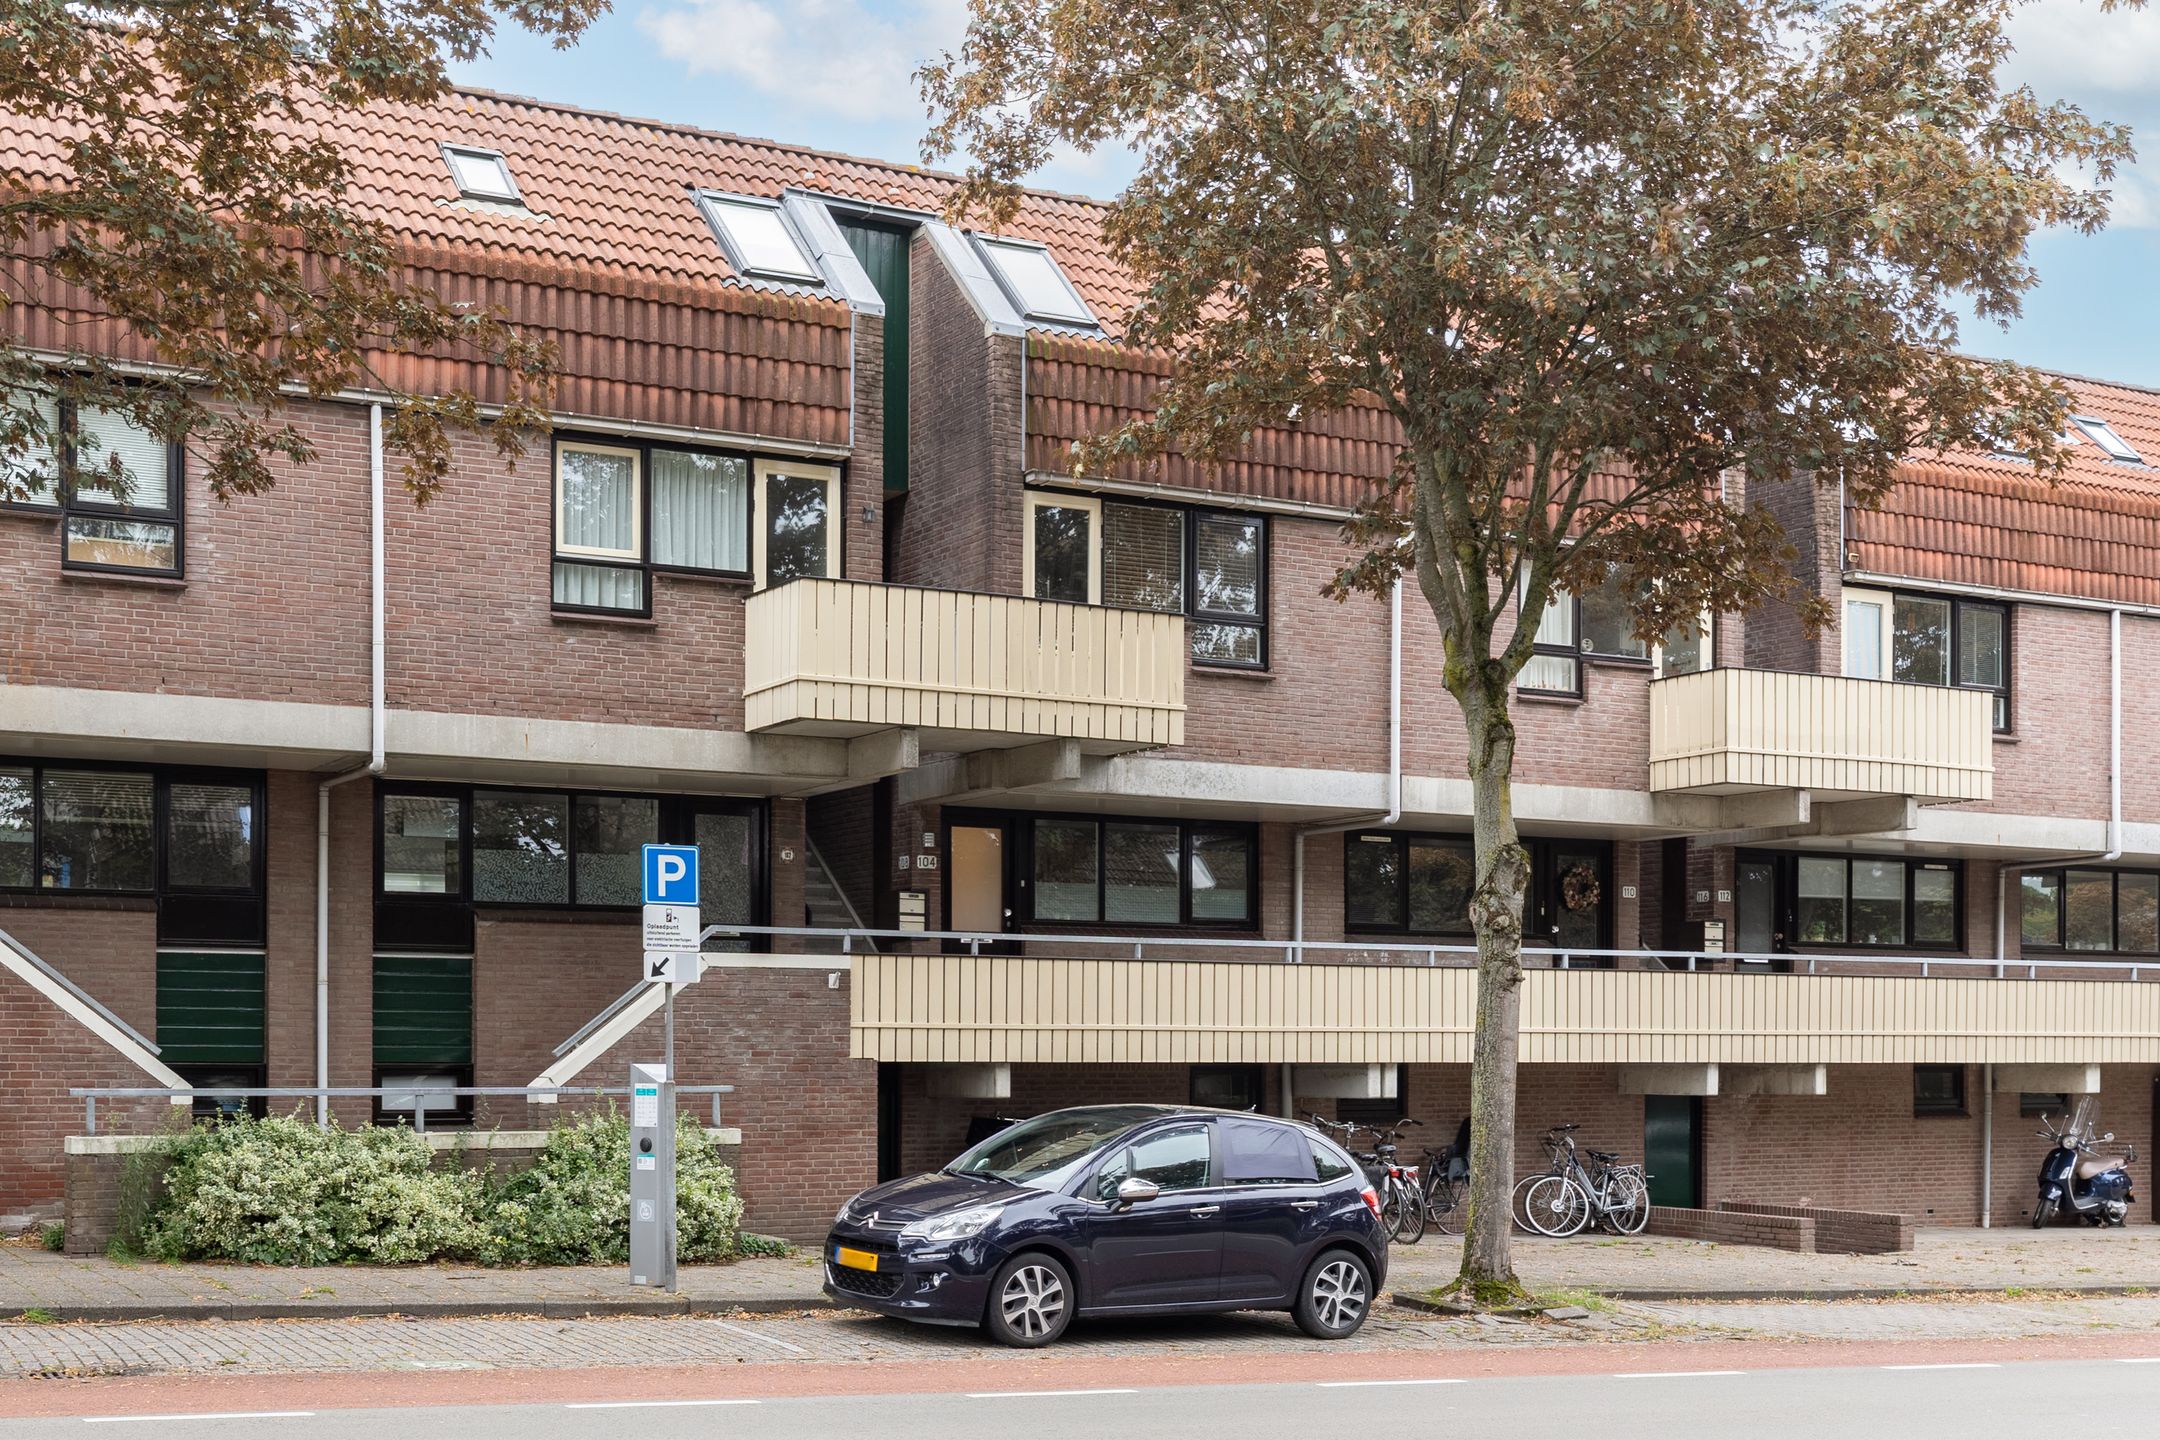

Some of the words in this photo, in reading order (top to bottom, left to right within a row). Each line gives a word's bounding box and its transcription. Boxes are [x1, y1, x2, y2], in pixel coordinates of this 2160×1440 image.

[918, 857, 936, 868] 104
[657, 854, 687, 897] P
[1624, 887, 1635, 897] 110
[1697, 892, 1709, 902] 116
[1719, 891, 1730, 901] 112
[646, 923, 679, 931] Oplaadpunt
